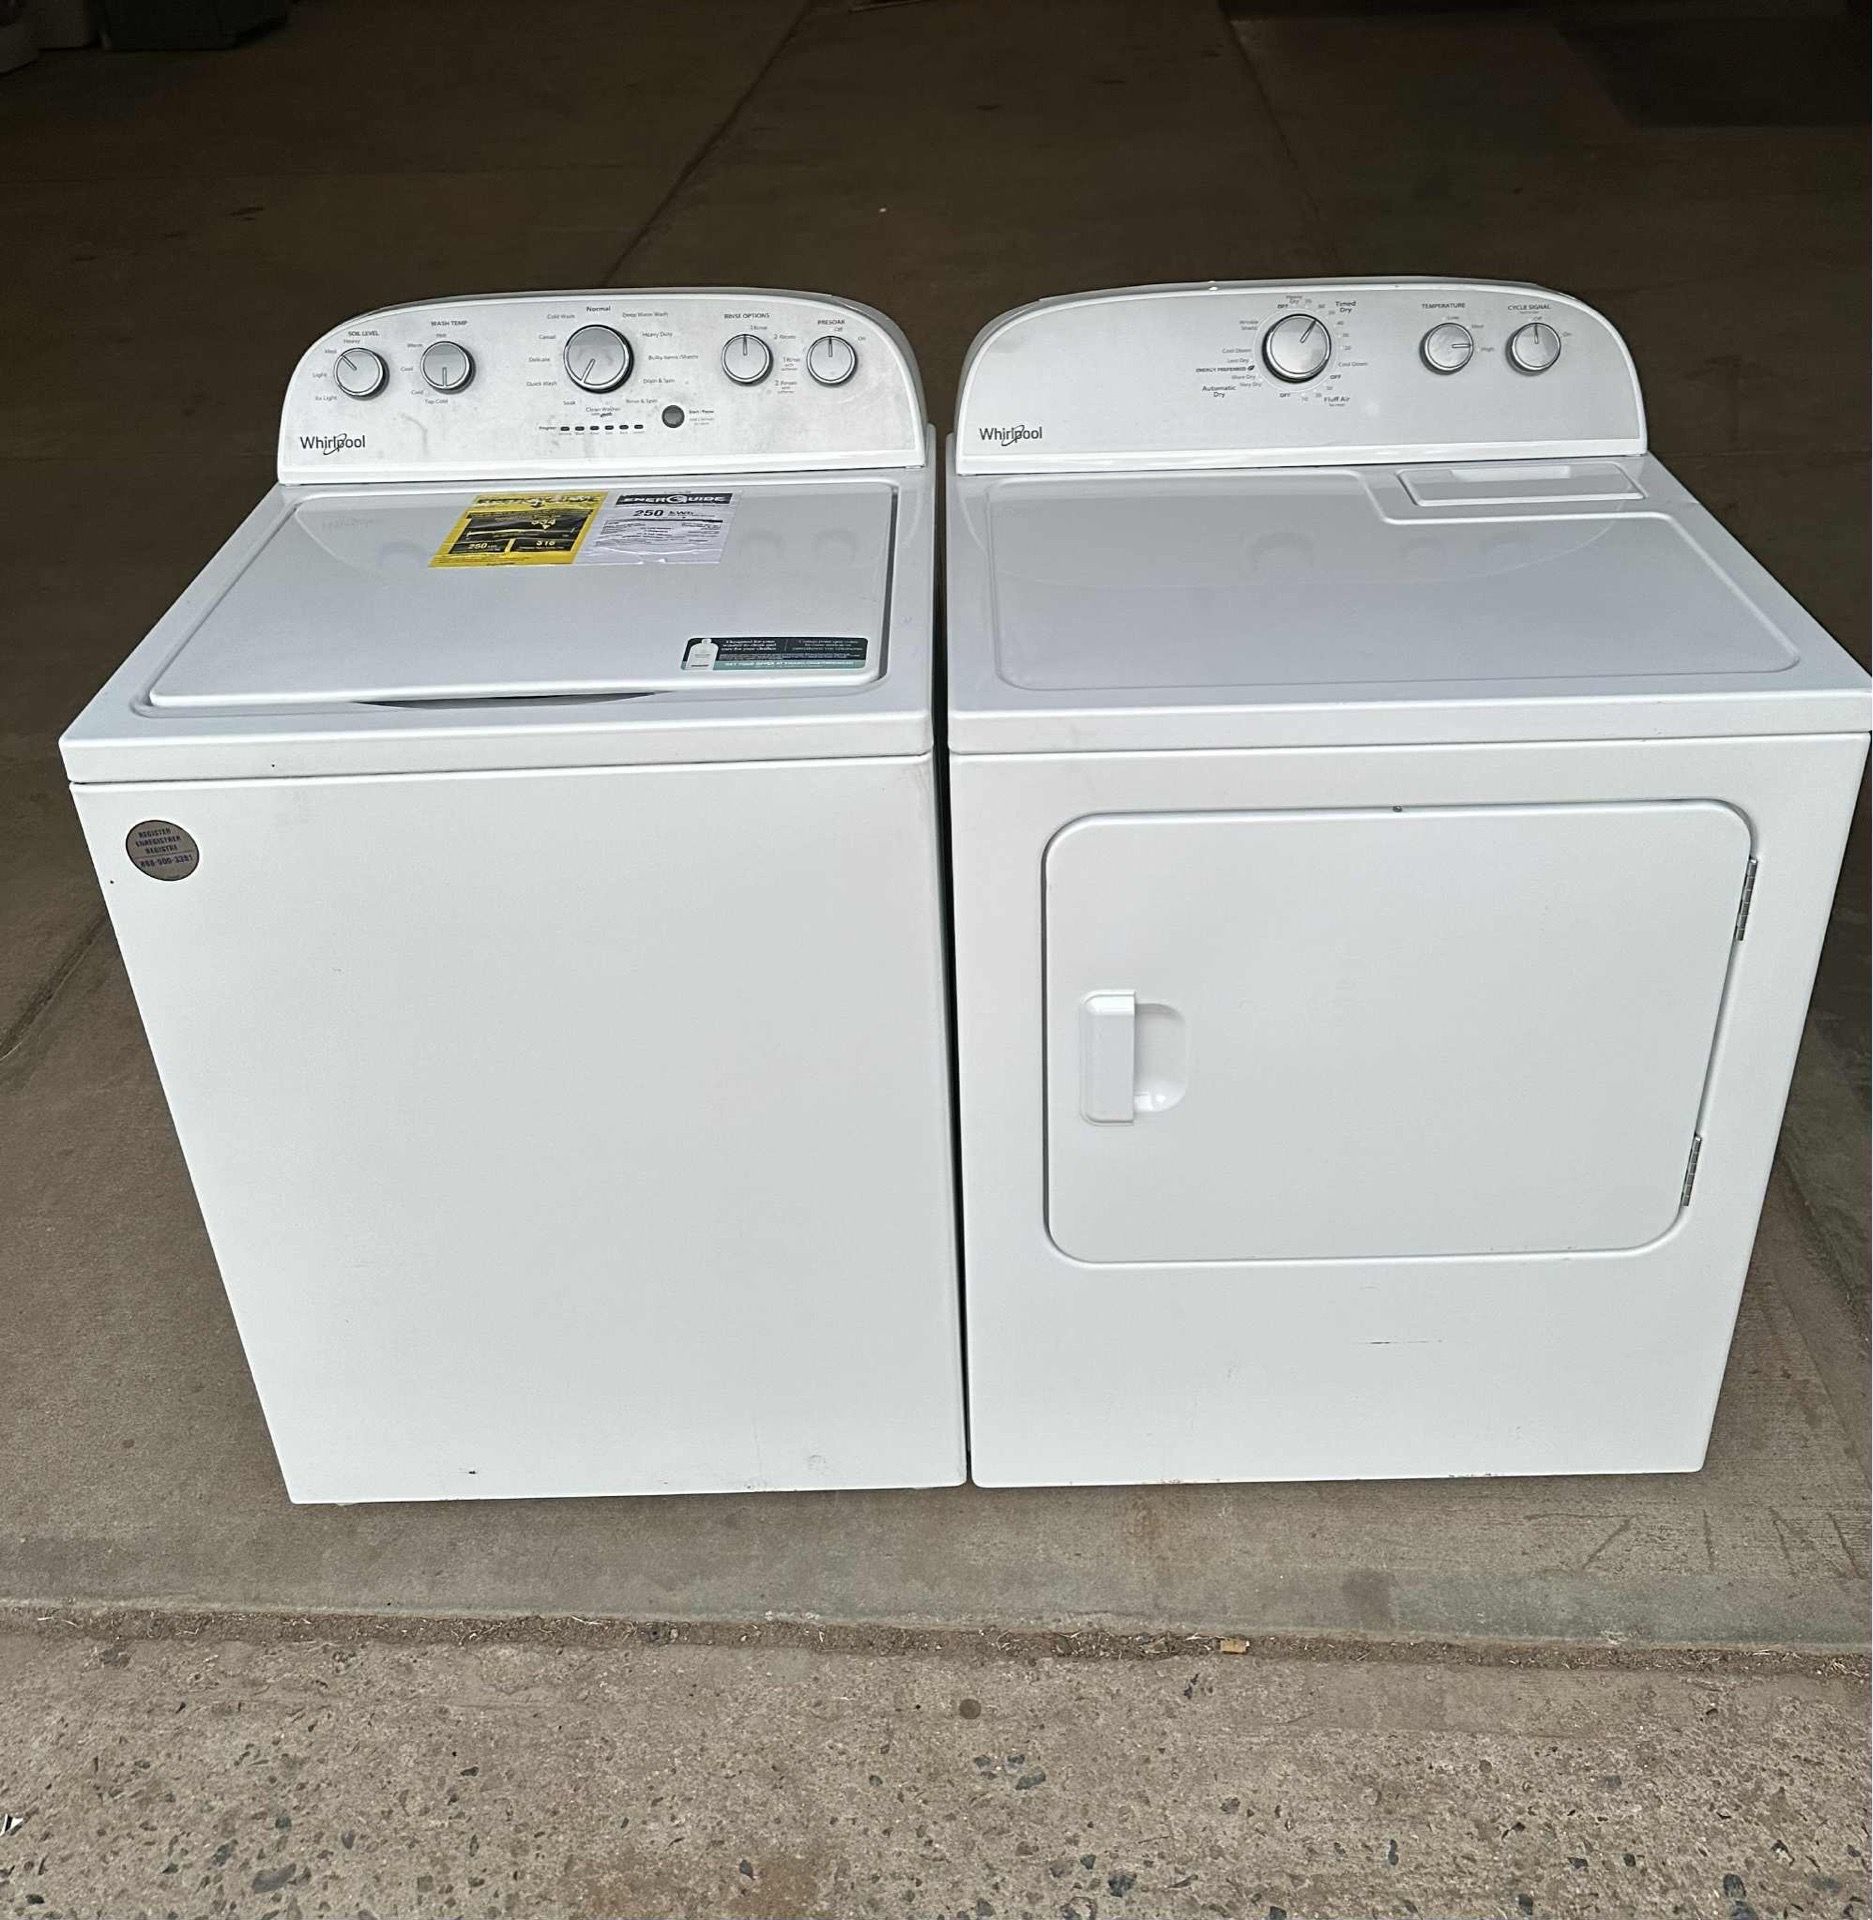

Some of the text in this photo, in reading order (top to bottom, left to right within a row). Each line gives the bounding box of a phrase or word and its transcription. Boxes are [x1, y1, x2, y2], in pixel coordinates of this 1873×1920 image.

[979, 426, 1042, 446] Whirlpool
[300, 434, 366, 454] Whirlpool
[632, 509, 664, 517] 250
[138, 828, 171, 838] REGISTER
[136, 835, 182, 847] ENREGISTRER
